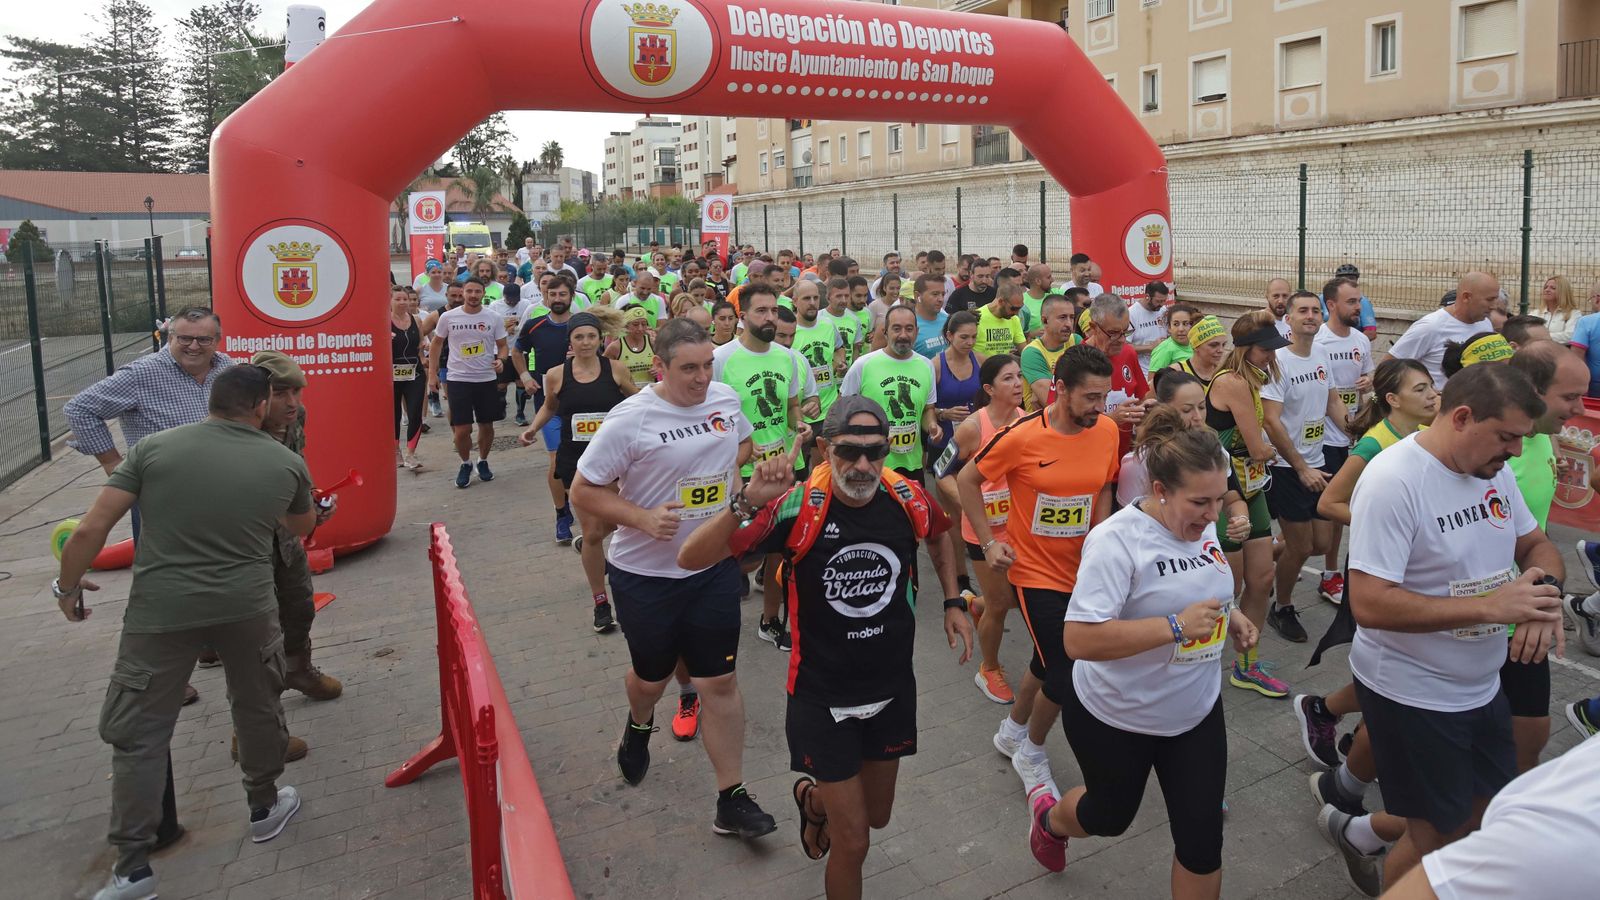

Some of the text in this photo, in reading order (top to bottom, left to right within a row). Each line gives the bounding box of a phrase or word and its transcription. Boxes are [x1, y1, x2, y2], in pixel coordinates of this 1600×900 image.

[727, 4, 995, 56] Delegación de Deportes
[730, 45, 995, 87] Ilustre Ayuntamiento de San Roque
[1111, 284, 1146, 297] Delegaci
[226, 332, 373, 353] Delegación de Deportes
[317, 352, 329, 364] de
[331, 352, 348, 363] San
[350, 351, 373, 363] Roque
[1339, 393, 1356, 404] 92
[576, 420, 604, 433] 20
[691, 486, 719, 505] 92
[985, 500, 1010, 515] 16
[1040, 507, 1083, 524] 231
[822, 564, 888, 581] Donando
[823, 580, 887, 600] Vidas
[847, 625, 883, 639] mobel
